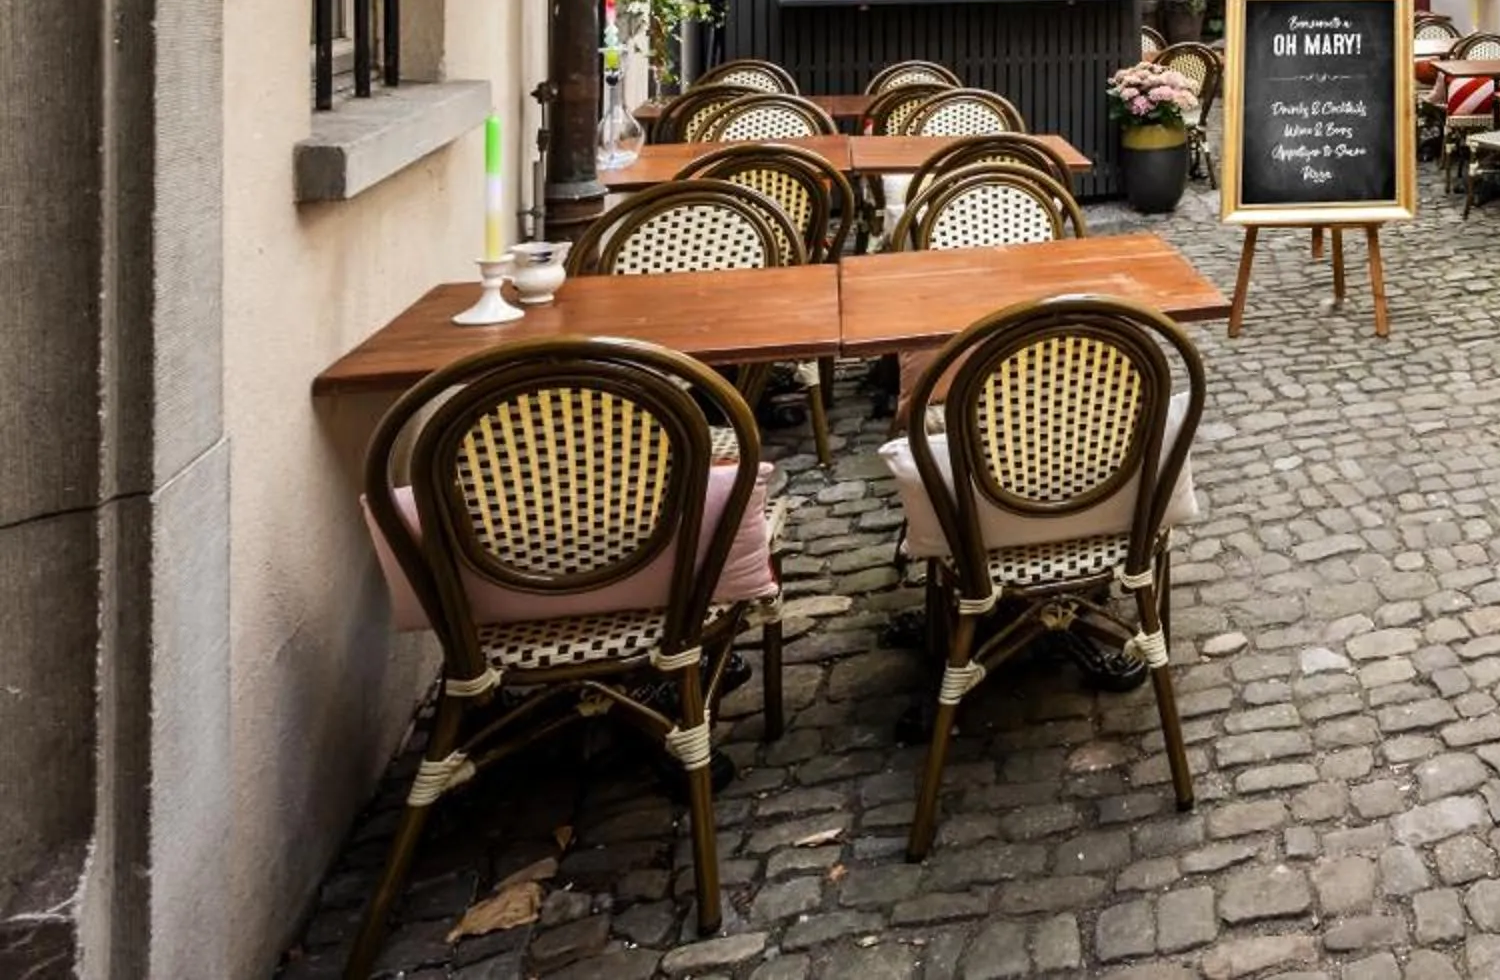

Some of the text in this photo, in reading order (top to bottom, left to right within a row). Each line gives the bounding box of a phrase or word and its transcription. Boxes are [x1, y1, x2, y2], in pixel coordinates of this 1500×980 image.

[1273, 33, 1361, 56] OH MARY!
[1271, 101, 1309, 118] Drinks
[1311, 101, 1321, 116] &
[1284, 123, 1312, 137] Wine
[1314, 121, 1322, 137] &
